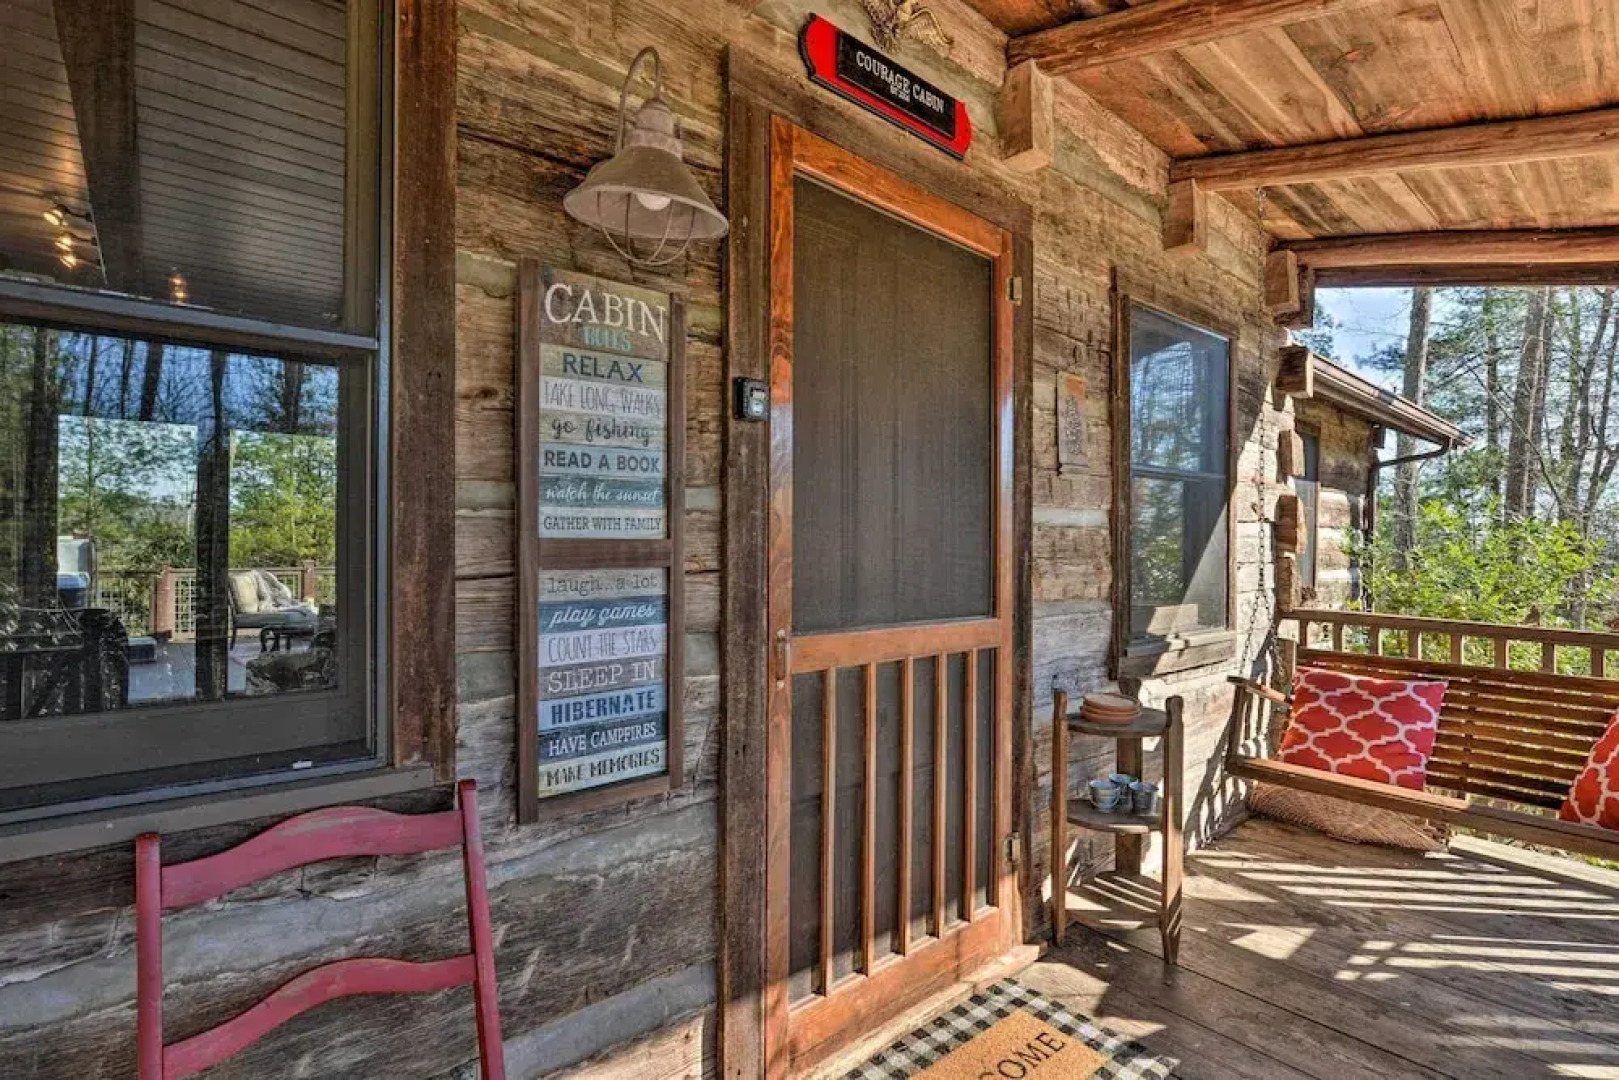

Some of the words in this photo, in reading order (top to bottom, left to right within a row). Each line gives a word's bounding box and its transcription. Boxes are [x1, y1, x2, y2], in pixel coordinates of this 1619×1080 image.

[856, 51, 911, 93] COURAGE
[912, 83, 945, 114] CABIN
[545, 282, 666, 343] CABIN
[562, 352, 644, 383] RELAX
[544, 381, 574, 408] TAKE
[580, 385, 615, 411] LONG
[621, 390, 660, 417] WALKS
[552, 419, 578, 439] go
[585, 417, 650, 447] fishing
[544, 449, 592, 469] READ
[598, 454, 611, 470] A
[616, 455, 660, 473] BOOK
[545, 481, 587, 503] watch
[593, 482, 611, 504] the
[616, 487, 661, 505] sunset
[543, 516, 590, 531] GATHER
[592, 517, 621, 531] WITH
[624, 517, 661, 531] FAMILY
[632, 573, 657, 589] lot
[549, 607, 596, 628] play
[597, 603, 656, 626] games
[548, 635, 592, 663] COUNT
[597, 632, 616, 658] THE
[623, 628, 656, 655] STARS
[548, 664, 623, 694] SLEEP
[631, 661, 656, 682] IN
[551, 690, 655, 725] HIBERNATE
[549, 735, 586, 757] HAVE
[590, 722, 657, 749] CAMPFIRES
[546, 763, 584, 788] MAKE
[590, 748, 660, 778] MEMORIES
